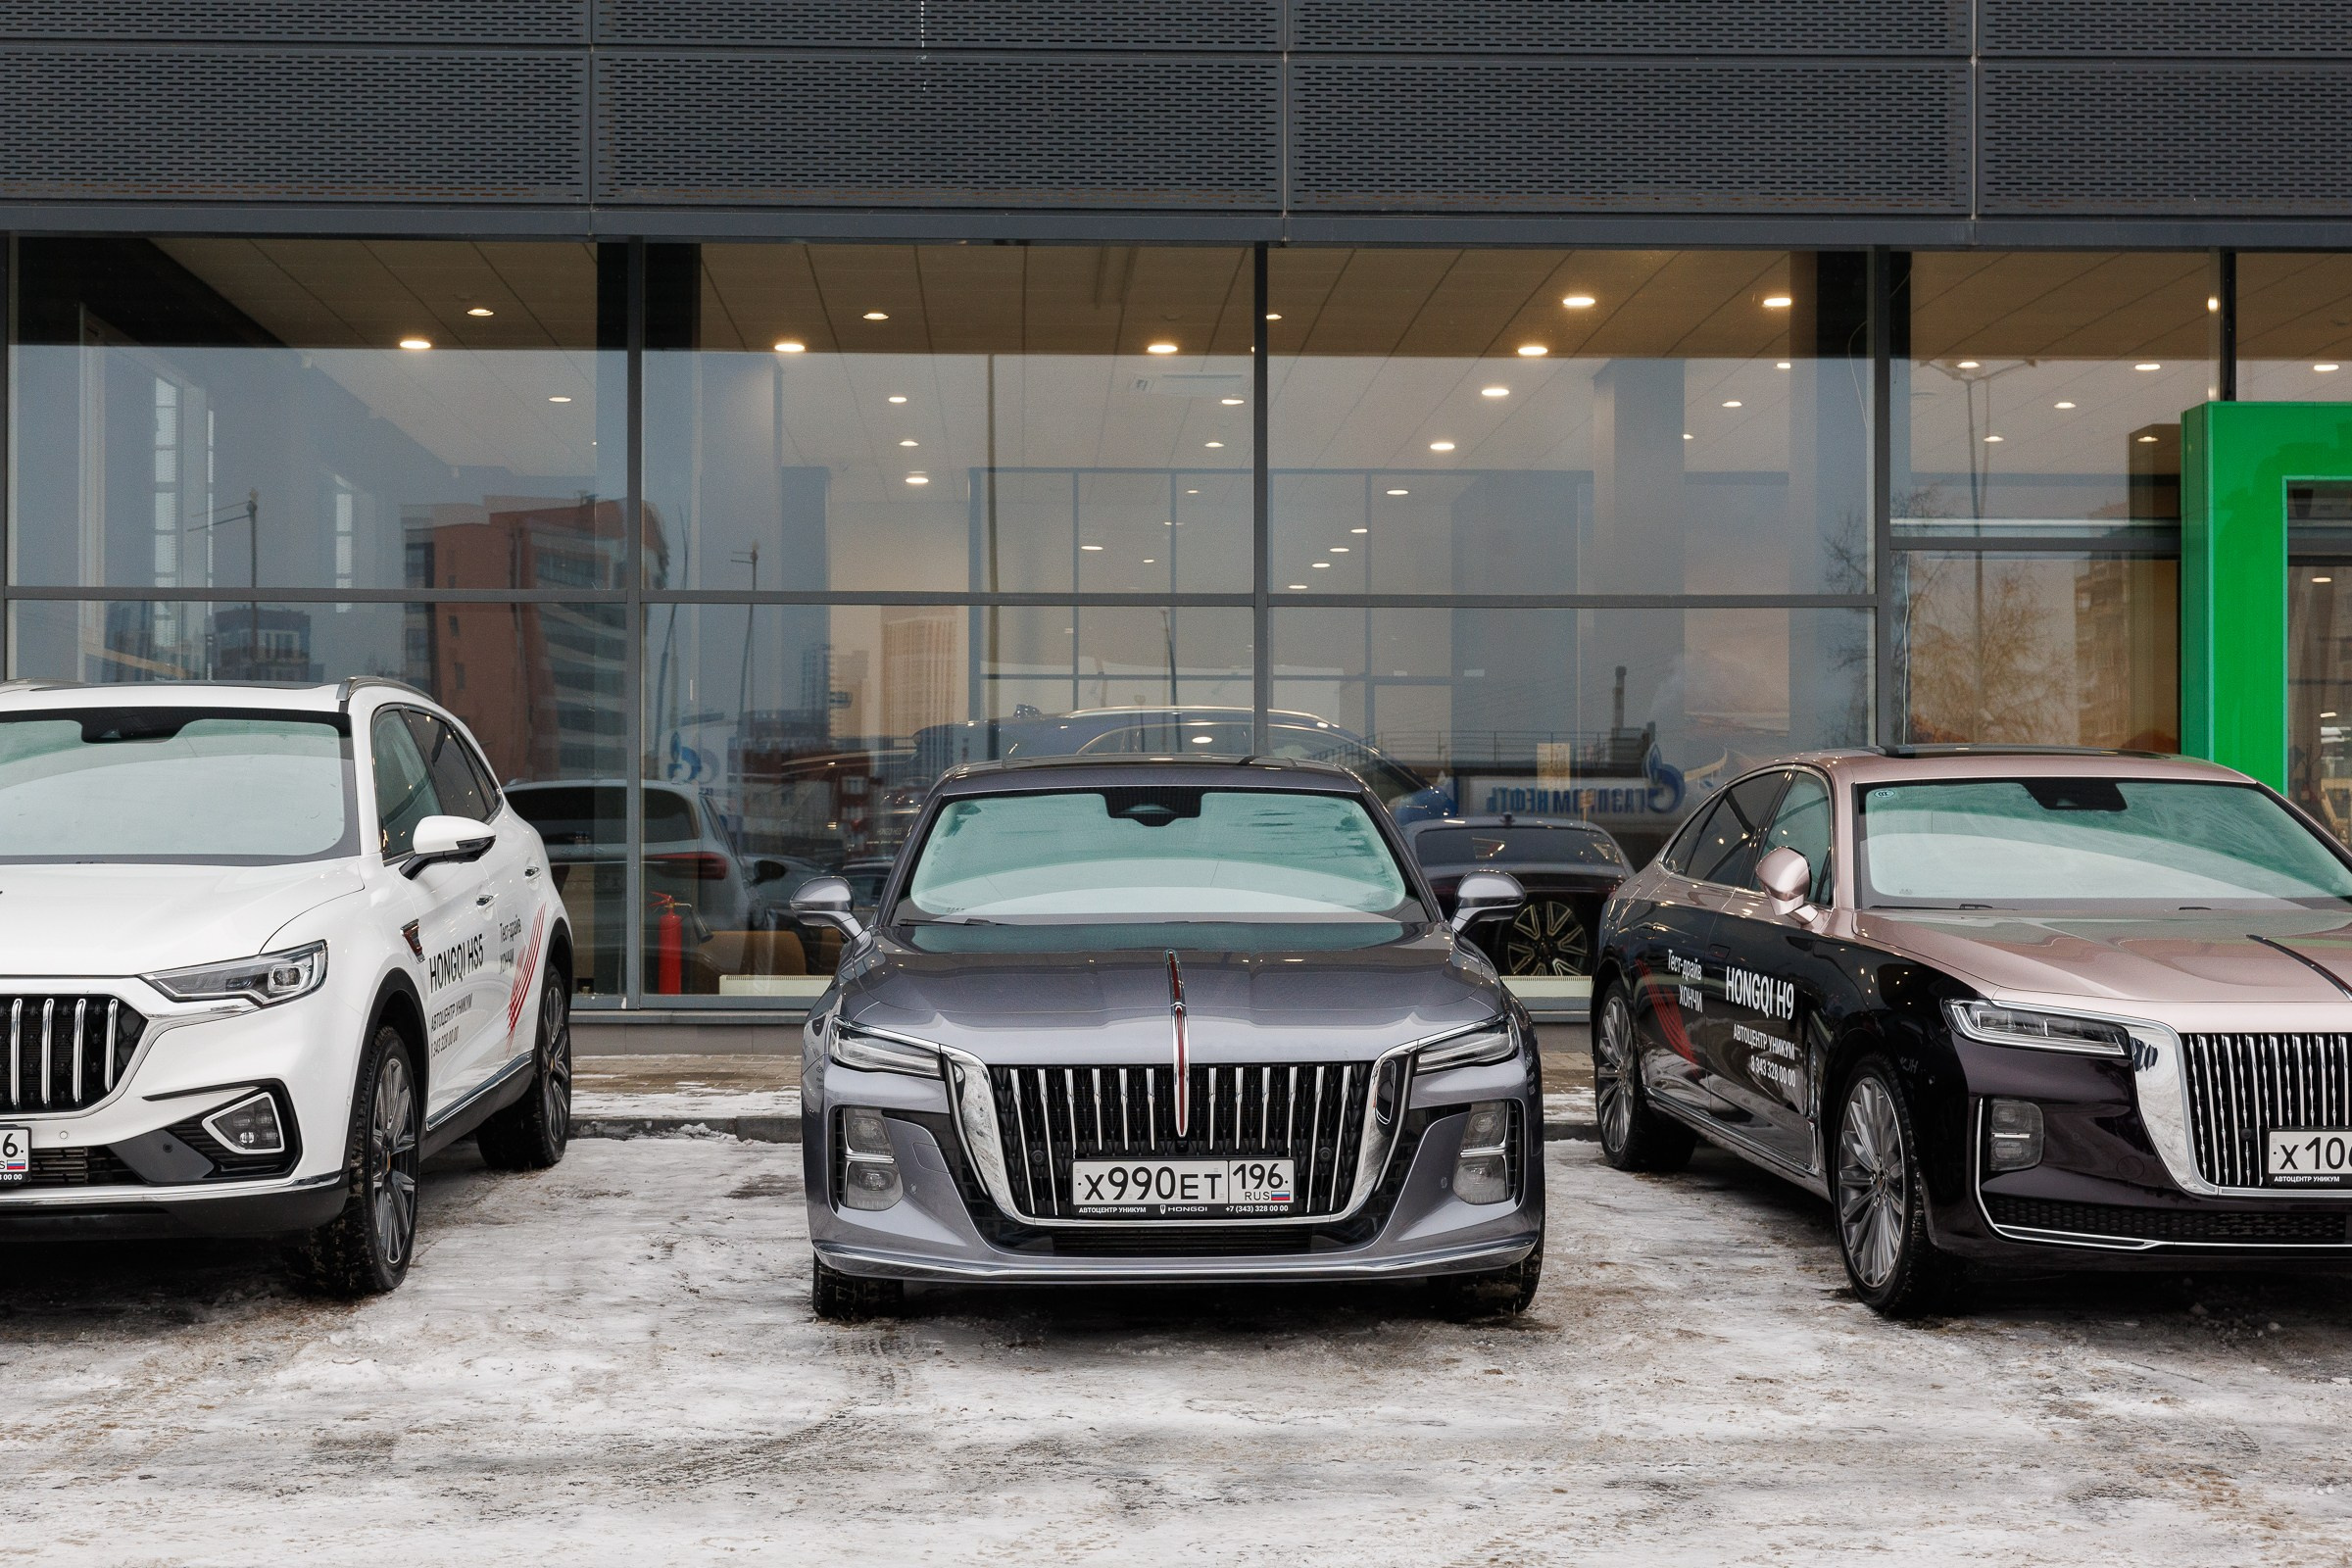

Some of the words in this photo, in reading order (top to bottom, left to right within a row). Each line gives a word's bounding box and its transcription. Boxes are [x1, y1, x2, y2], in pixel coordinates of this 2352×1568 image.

[500, 914, 521, 943] Тест-драйв
[429, 942, 466, 994] HONGQI
[467, 933, 484, 974] HS5
[1668, 949, 1702, 981] Тест-драйв
[1679, 984, 1702, 1013] ХОНЧИ
[1726, 966, 1774, 1018] HONGQI
[1776, 980, 1794, 1020] H9
[1733, 1023, 1768, 1051] АВТОЦЕНТР
[1768, 1034, 1795, 1061] УНИКУМ
[1750, 1054, 1755, 1070] 8
[1755, 1058, 1767, 1078] 343
[1768, 1063, 1779, 1081] 328
[1779, 1066, 1788, 1084] 00
[1788, 1069, 1796, 1088] 00
[2279, 1137, 2352, 1170] Х10
[1232, 1163, 1284, 1190] 196
[1245, 1191, 1270, 1200] RUS
